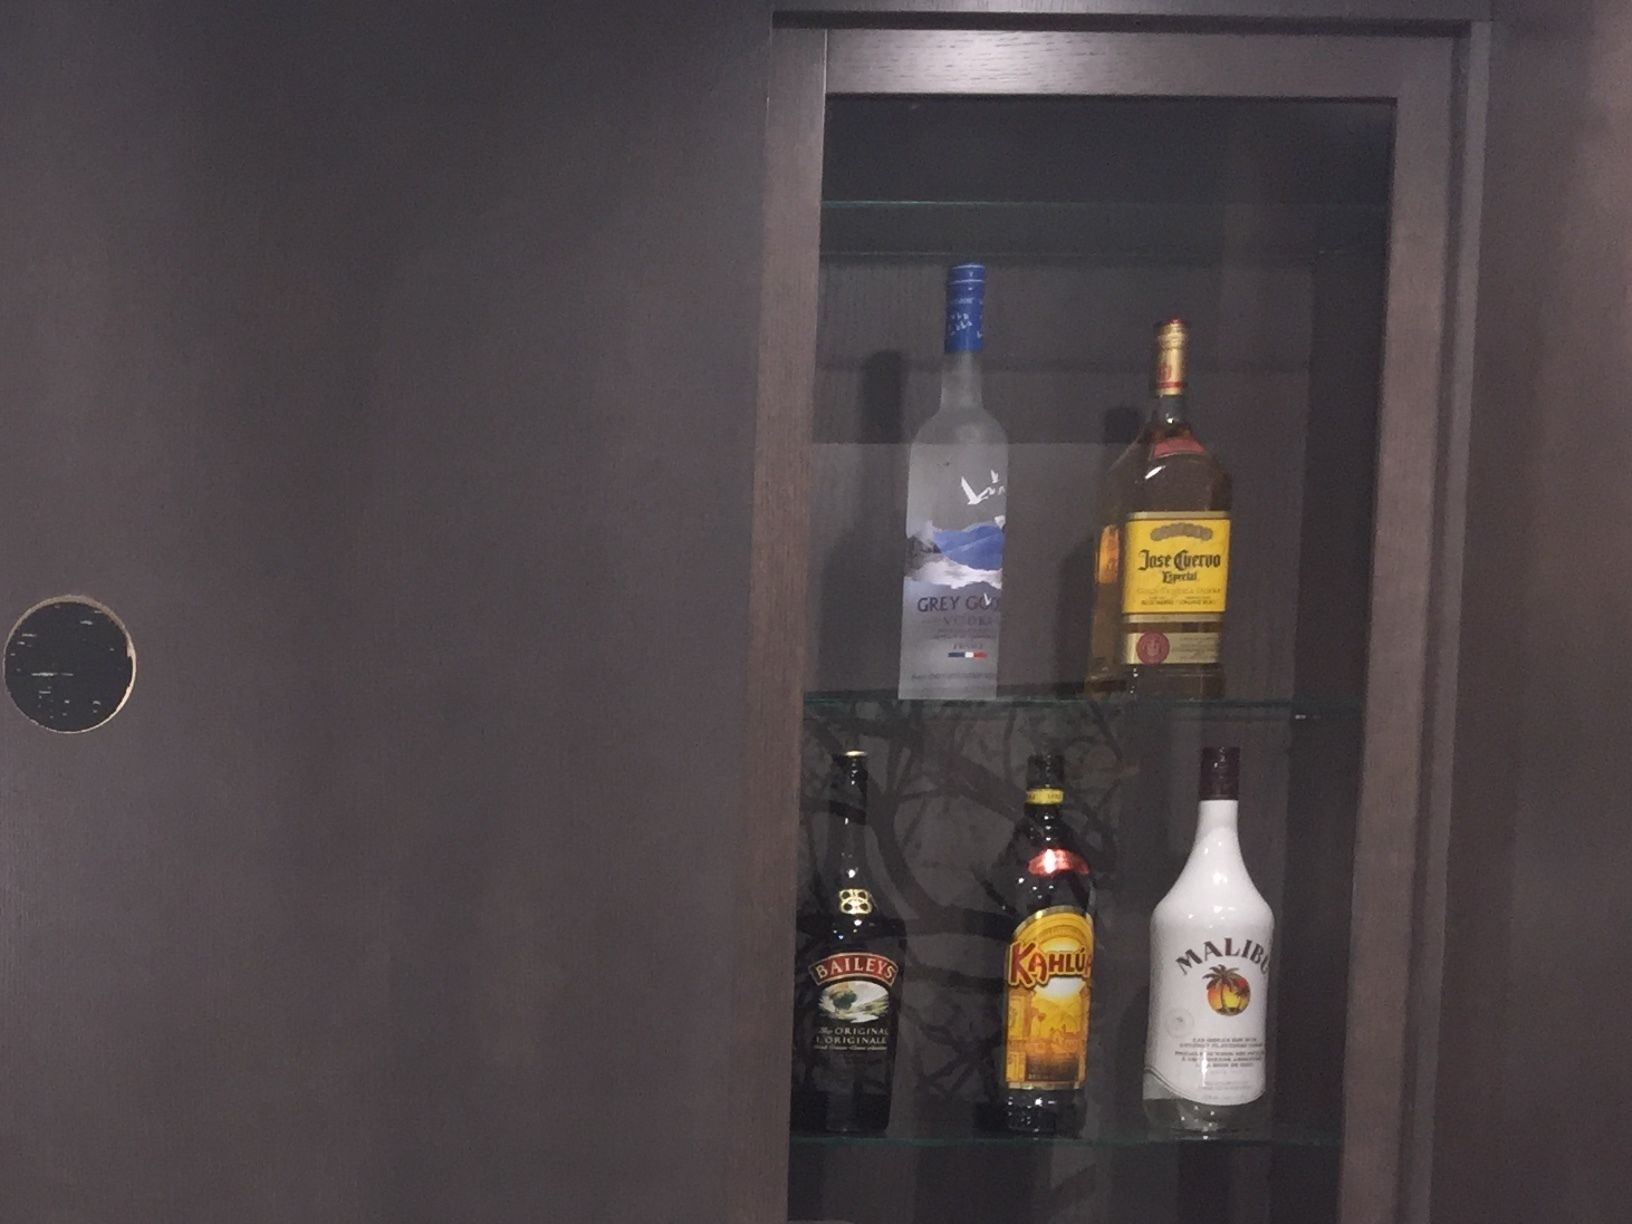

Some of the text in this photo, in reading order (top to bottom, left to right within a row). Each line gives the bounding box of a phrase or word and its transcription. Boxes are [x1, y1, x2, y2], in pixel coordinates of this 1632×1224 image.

[1138, 549, 1222, 571] Jose Cuervo
[1161, 570, 1198, 584] Especial
[917, 596, 960, 612] GREY
[815, 957, 897, 980] BAILEYS
